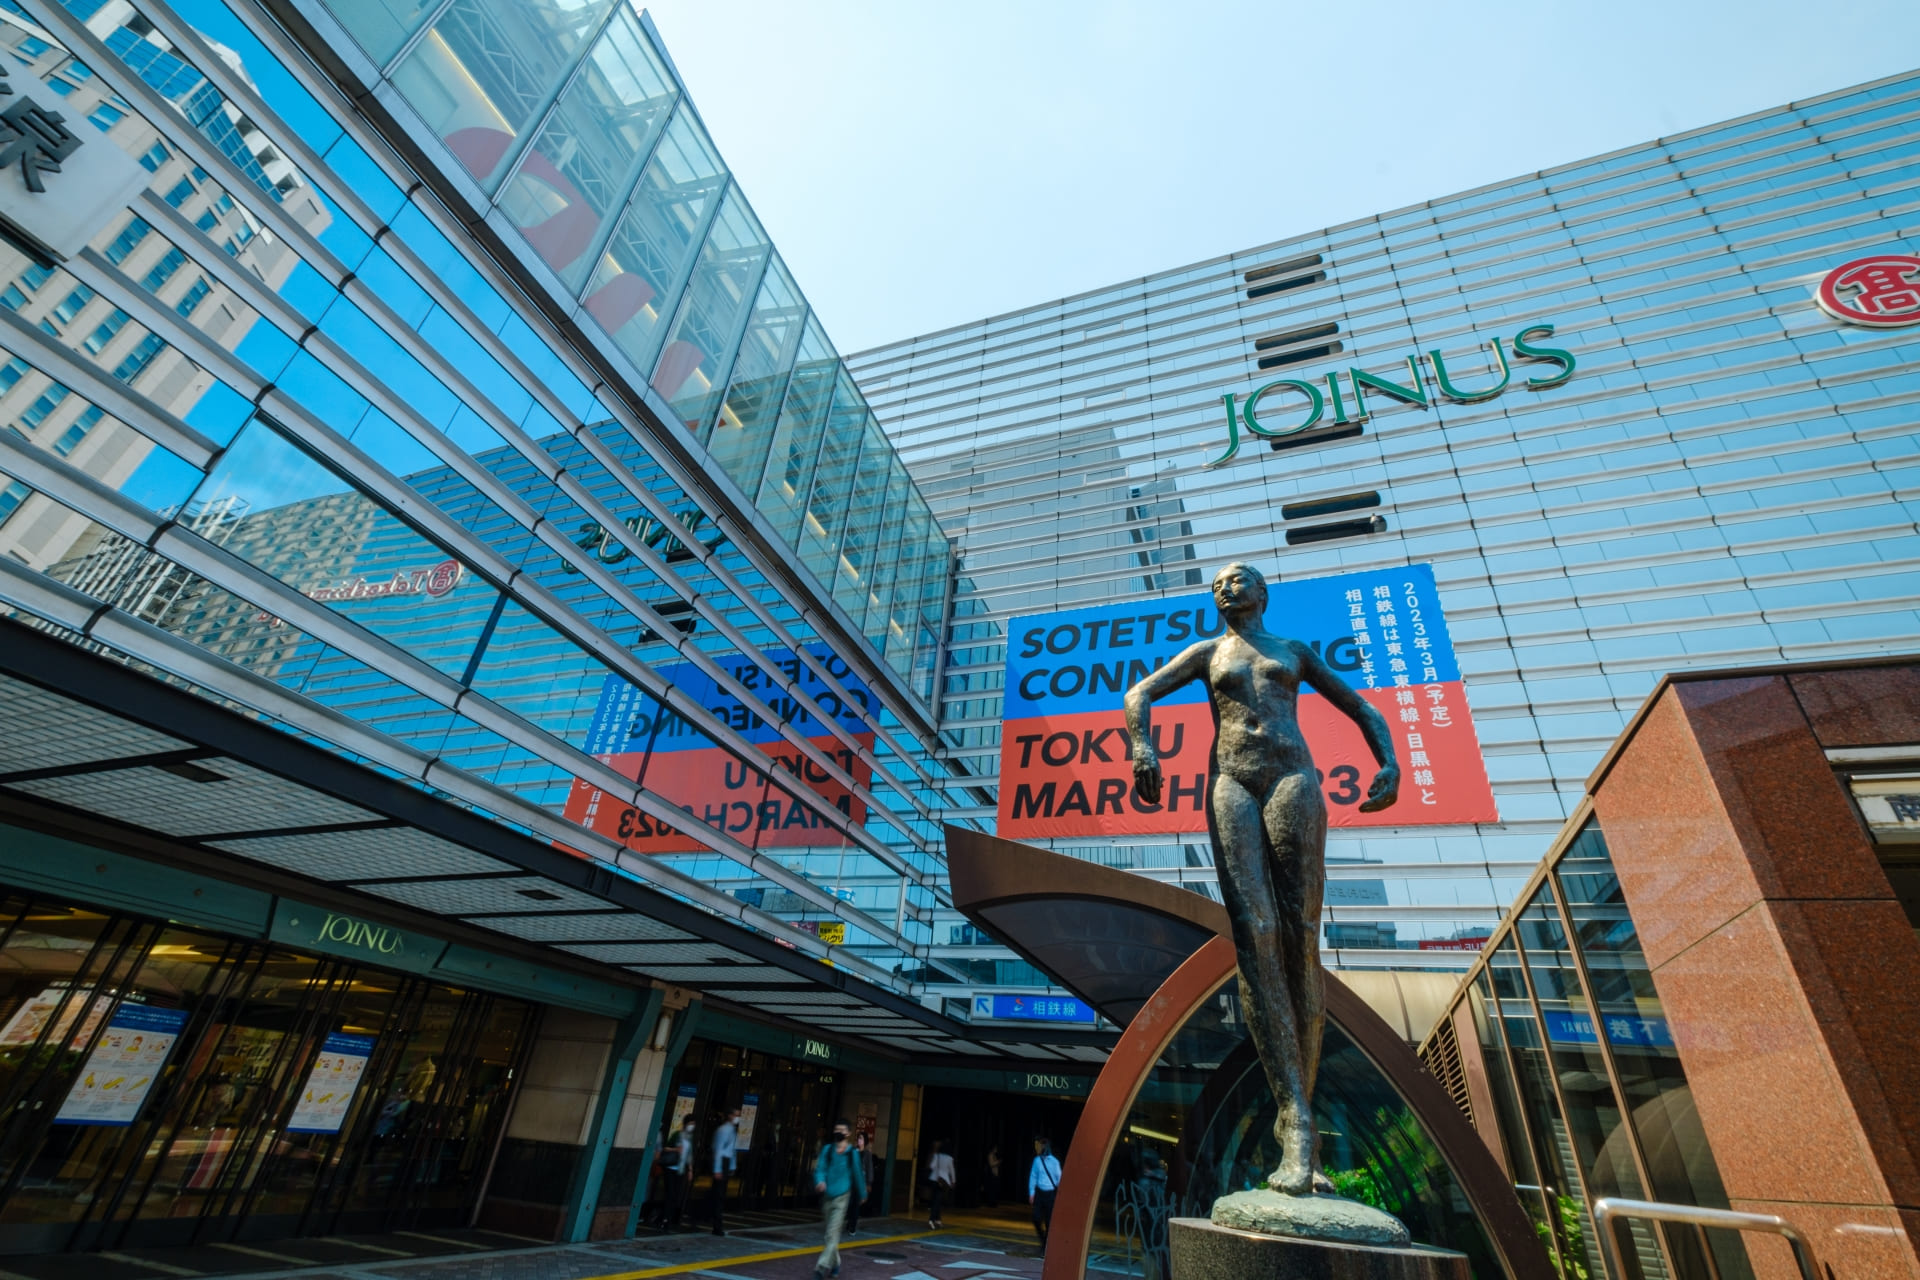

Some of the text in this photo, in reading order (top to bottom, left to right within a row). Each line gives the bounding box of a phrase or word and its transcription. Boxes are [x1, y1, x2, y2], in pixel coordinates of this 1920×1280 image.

[1202, 323, 1577, 469] JOINUS
[1019, 607, 1226, 659] SOTETSU
[1344, 588, 1383, 694] 相互直通します。
[1015, 722, 1185, 769] TOKYU
[1011, 773, 1206, 820] MARCH
[1032, 999, 1077, 1017] 相鉄線
[803, 1038, 832, 1060] JOINUS
[1025, 1072, 1070, 1090] JOINUS
